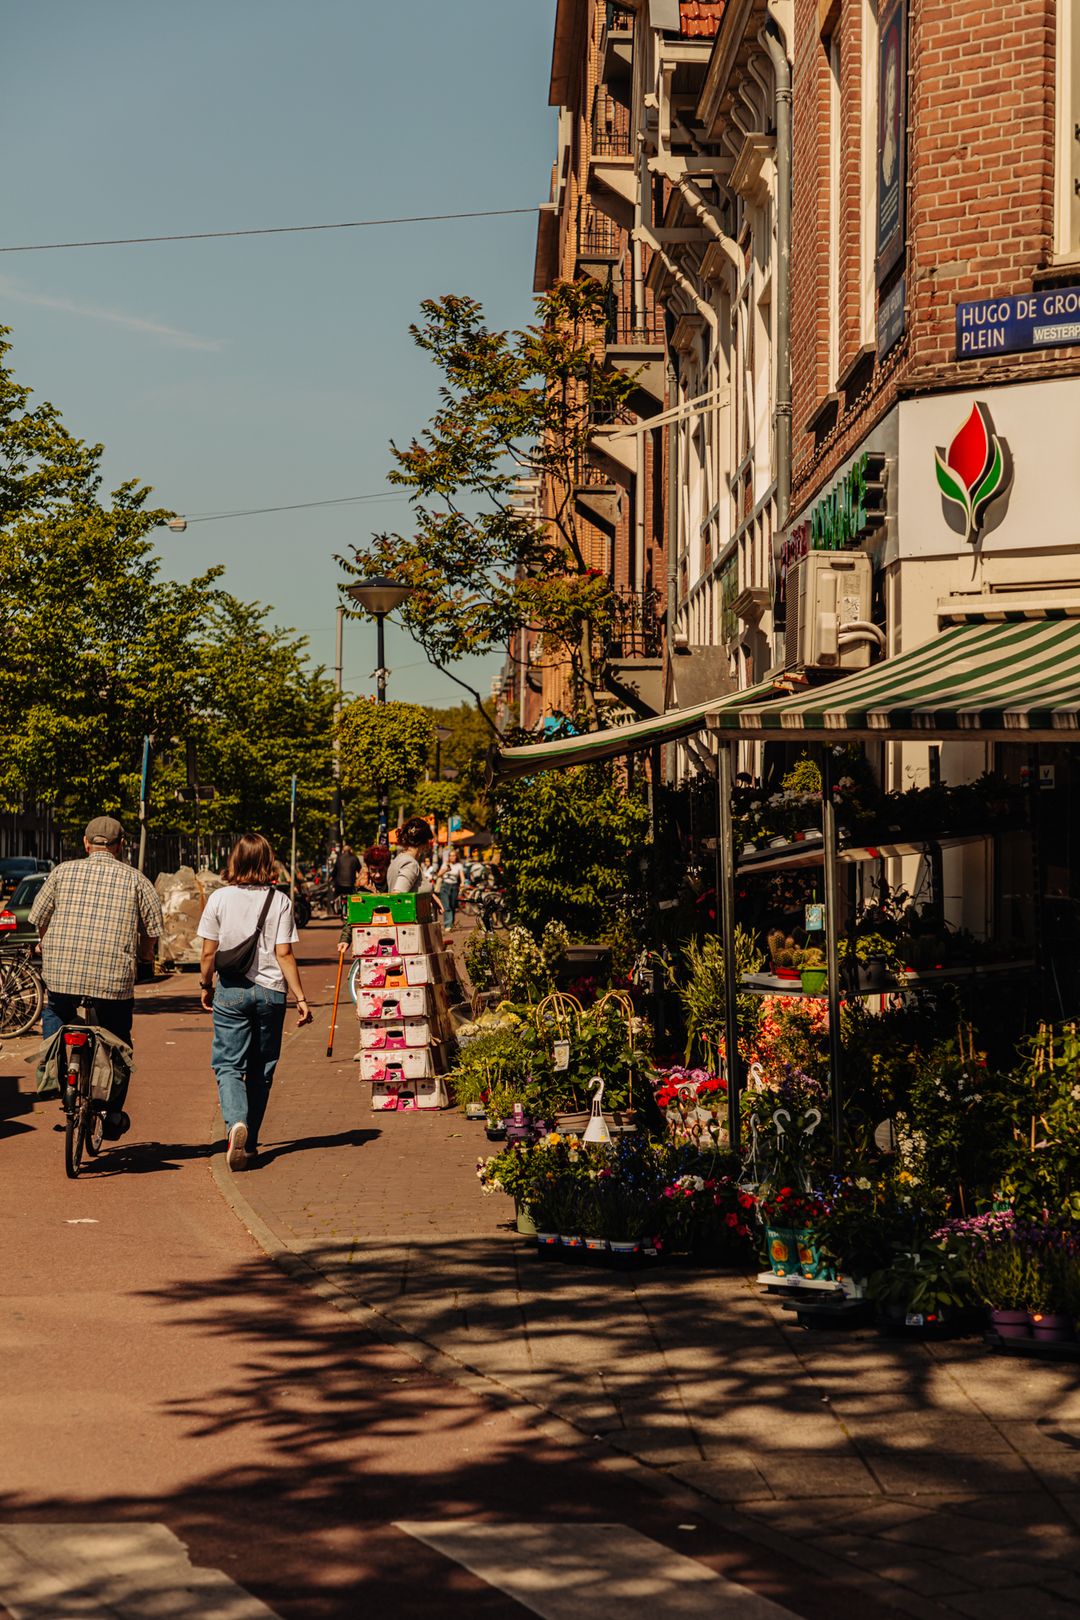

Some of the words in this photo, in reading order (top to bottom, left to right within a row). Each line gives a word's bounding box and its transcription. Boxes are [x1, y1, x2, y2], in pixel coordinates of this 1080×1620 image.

[962, 303, 1010, 327] HUGO
[1017, 299, 1037, 319] DE
[1043, 293, 1080, 315] GRO
[962, 327, 1005, 351] PLEIN
